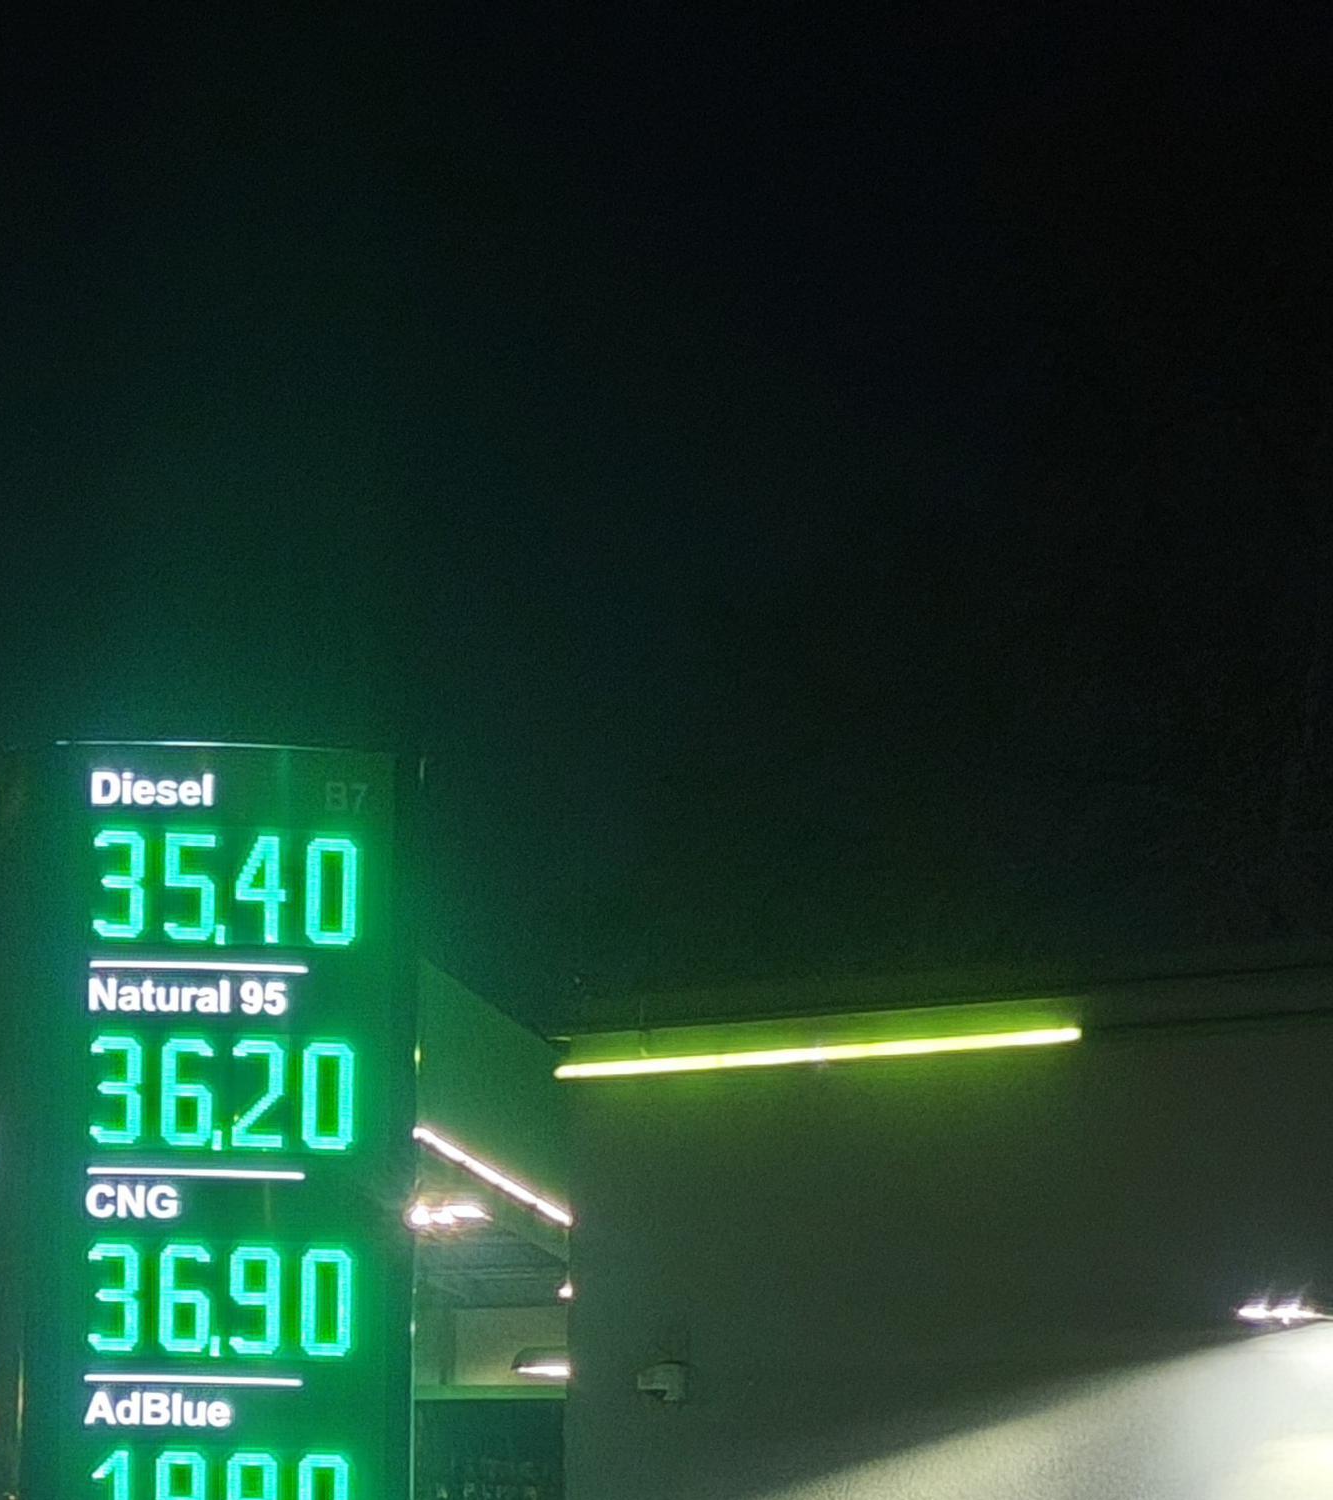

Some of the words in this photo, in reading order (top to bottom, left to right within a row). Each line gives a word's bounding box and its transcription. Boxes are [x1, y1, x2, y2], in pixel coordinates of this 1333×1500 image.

[91, 771, 214, 806] Diesel
[93, 830, 357, 945] 35,40
[88, 978, 231, 1013] Natural
[239, 981, 288, 1015] 95
[89, 1036, 354, 1151] 36,20
[85, 1184, 180, 1219] CNG
[87, 1243, 352, 1357] 36,90
[84, 1391, 232, 1427] AdBlue
